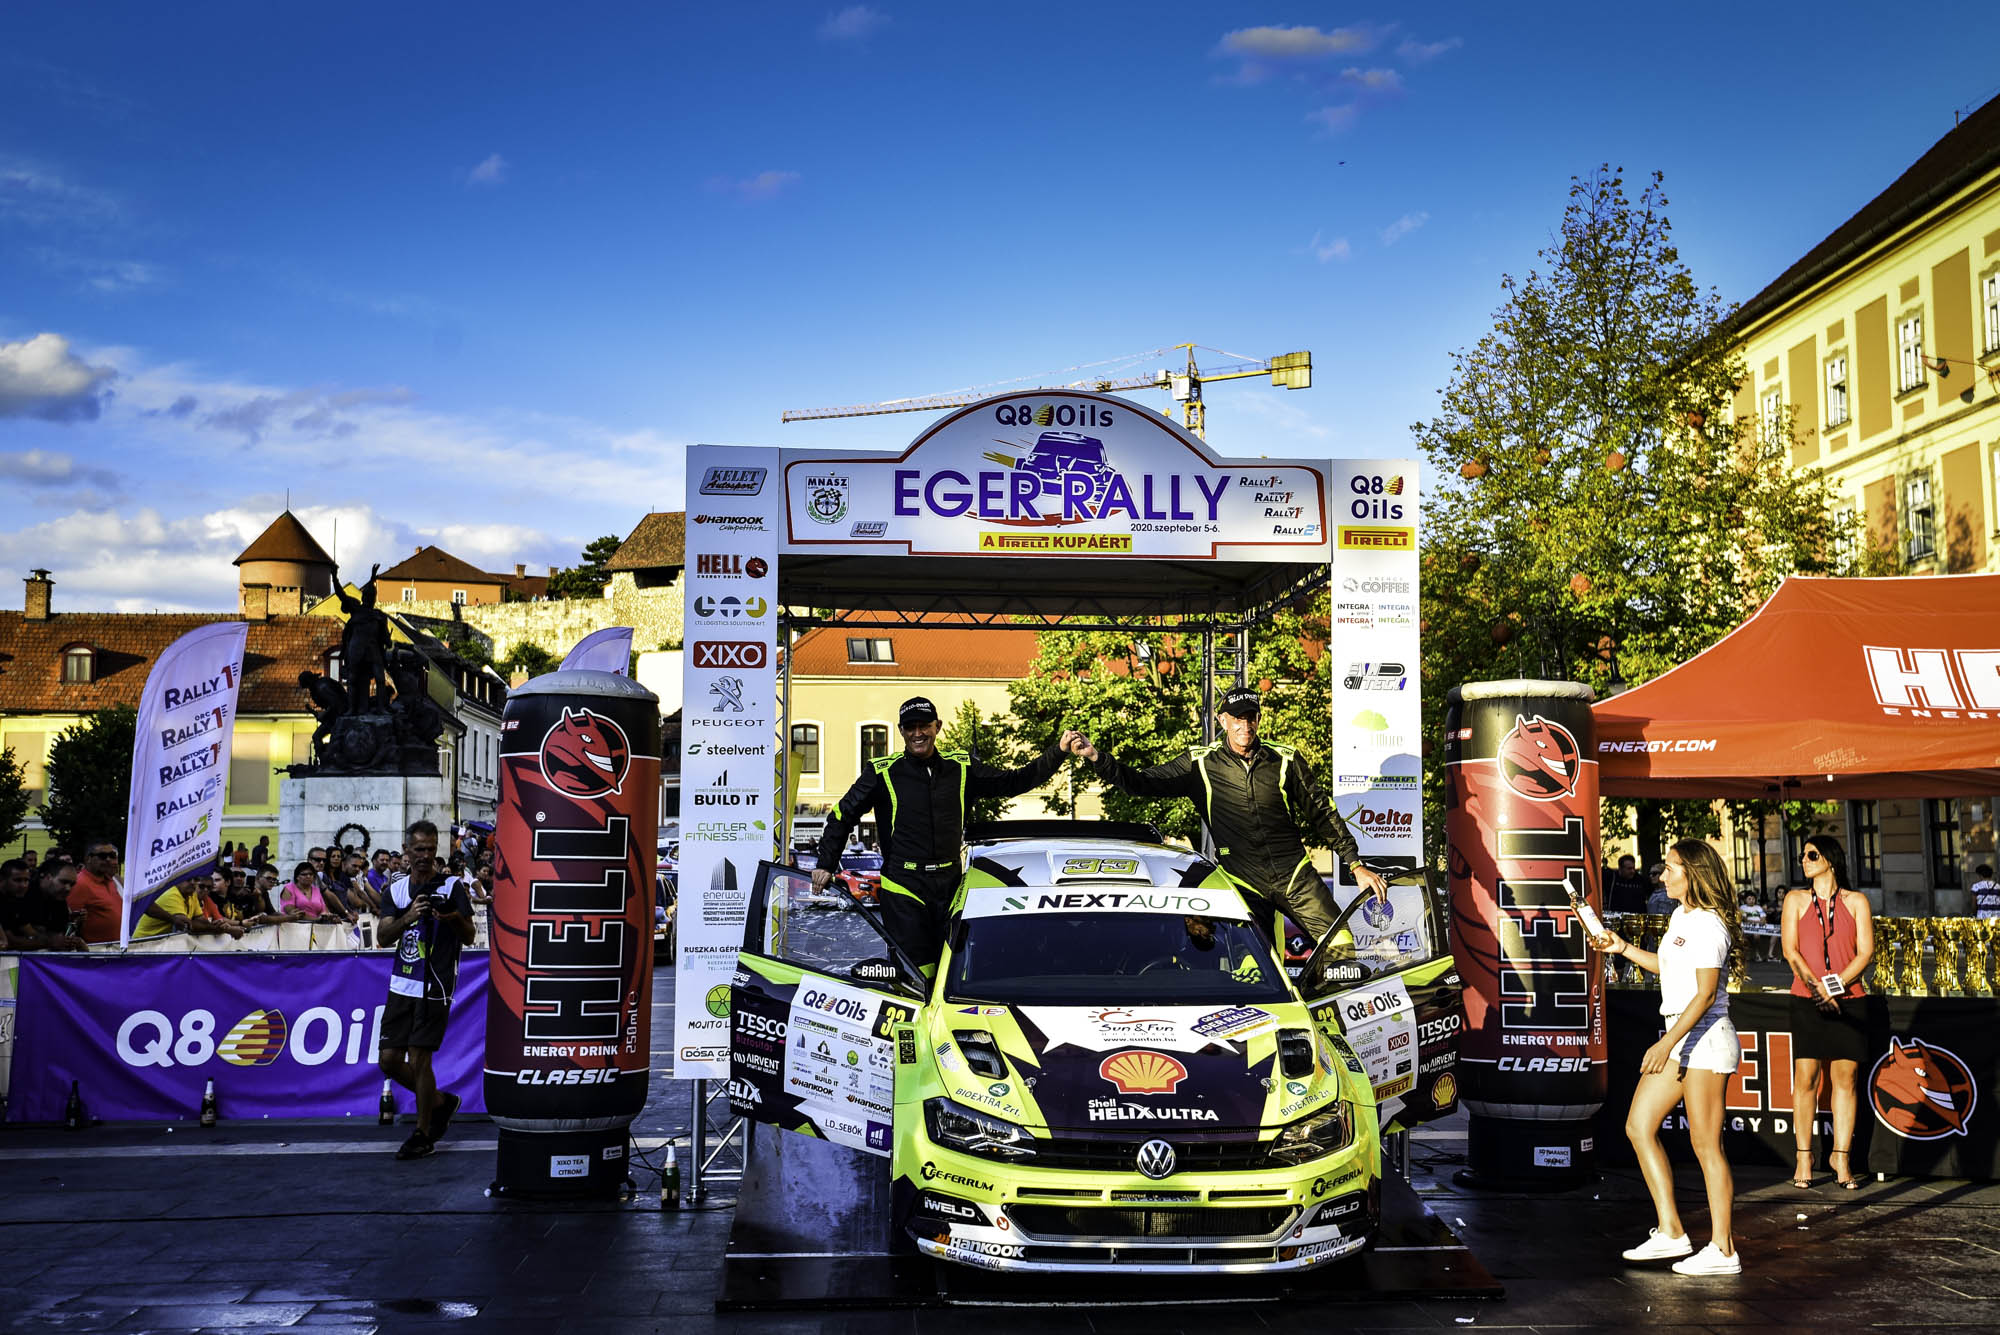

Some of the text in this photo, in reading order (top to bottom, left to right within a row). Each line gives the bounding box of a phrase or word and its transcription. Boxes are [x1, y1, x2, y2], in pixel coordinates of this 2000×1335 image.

[996, 404, 1113, 427] Q8 Oils
[711, 470, 760, 481] KELET
[807, 478, 848, 487] MNASZ
[705, 480, 759, 491] Autosport
[1351, 475, 1383, 496] Q8
[894, 469, 1232, 521] EGER RALLY
[1351, 499, 1403, 519] Oils
[1130, 523, 1221, 534] 2020.szepteber 5-6.
[983, 535, 1131, 549] A PIRELLI KUPÁÉRT
[1343, 530, 1409, 546] PIRELLI
[696, 554, 743, 575] HELL
[1361, 581, 1410, 594] COFFEE
[699, 644, 763, 666] XIXO
[194, 711, 211, 721] ORC
[691, 719, 766, 727] PEUGEOT
[180, 747, 209, 763] HISTORIC
[706, 744, 766, 756] steelvent
[694, 794, 760, 806] BUILD IT
[1360, 808, 1413, 825] Delta
[697, 822, 748, 832] CUTLER
[685, 832, 738, 841] FITNESS
[144, 859, 177, 879] MAGYAR
[1062, 857, 1141, 876] 33
[147, 869, 171, 885] RALLY
[702, 891, 746, 901] enerway
[523, 814, 631, 1042] HELL
[861, 964, 896, 978] BRAUN
[1326, 965, 1362, 979] BRAUN
[802, 989, 868, 1022] Q8 Oils
[1346, 991, 1402, 1022] Q8 Oils
[688, 1020, 723, 1029] MOJITO
[736, 1009, 788, 1038] TESCO
[1099, 1023, 1174, 1033] Sun & Fun
[1194, 1008, 1258, 1033] EGER RALLY
[1418, 1014, 1461, 1039] TESCO
[116, 1009, 216, 1068] Q8
[1389, 1034, 1409, 1050] XIXO
[1502, 1034, 1590, 1047] ENERGY DRINK
[523, 1044, 620, 1058] ENERGY DRINK
[685, 1047, 715, 1057] DÓSA
[1360, 1046, 1382, 1060] COFFEE
[746, 1052, 780, 1071] AIRVENT
[1429, 1051, 1457, 1068] AIRVENT
[1498, 1055, 1591, 1073] CLASSIC
[515, 1067, 622, 1085] CLASSIC
[814, 1075, 833, 1085] BUILD
[1375, 1076, 1410, 1100] PIRELLI
[955, 1087, 1021, 1117] BIOEXTRA Zrt.
[1088, 1098, 1117, 1109] Shell
[1280, 1093, 1320, 1117] BIOEXTRA
[1089, 1102, 1220, 1121] HELIX ULTRA
[869, 1138, 883, 1147] OVB
